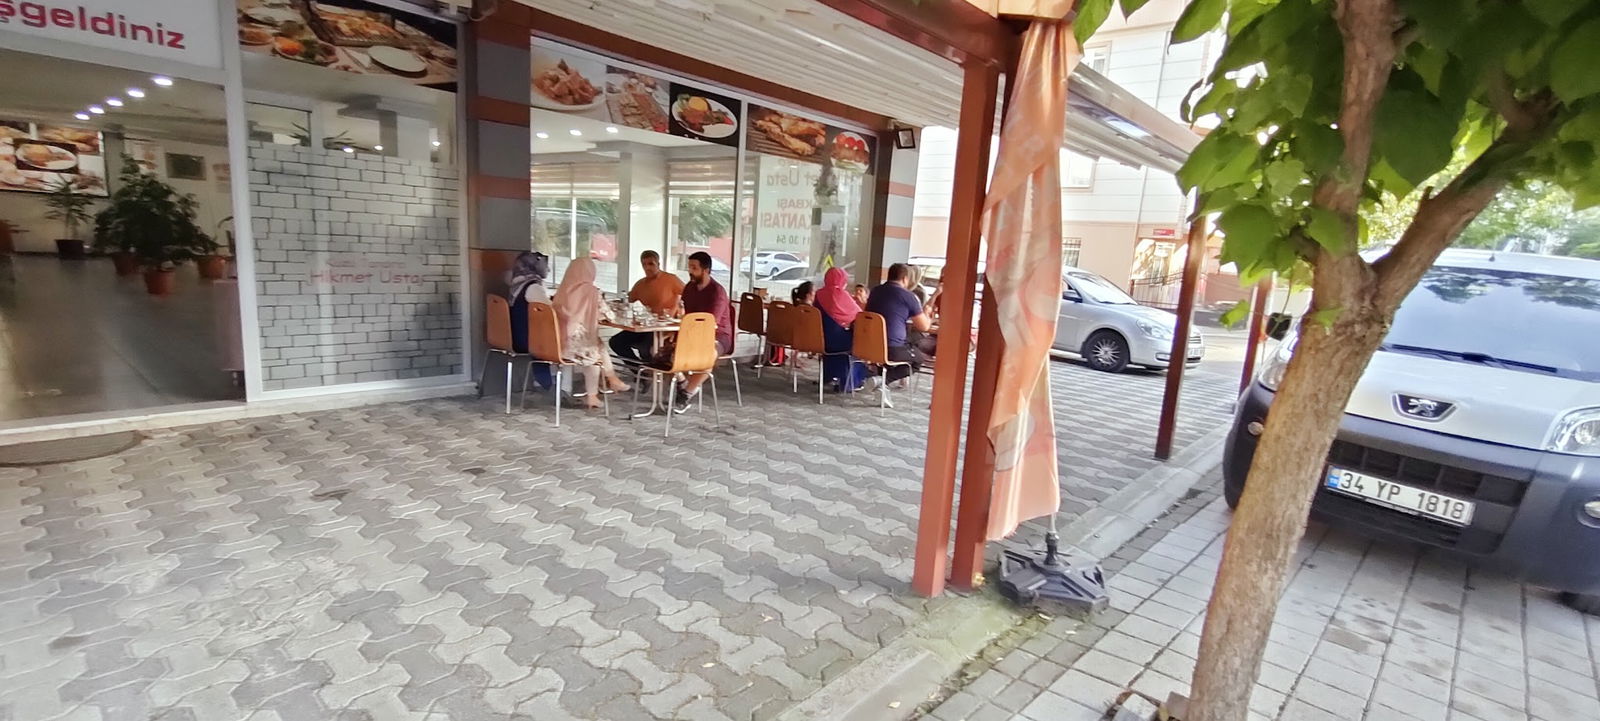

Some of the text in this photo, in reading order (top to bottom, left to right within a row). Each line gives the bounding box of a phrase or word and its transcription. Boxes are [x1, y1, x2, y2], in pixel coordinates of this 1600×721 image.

[1340, 472, 1364, 492] 34
[1377, 480, 1400, 501] YP
[1417, 492, 1465, 519] 1818
